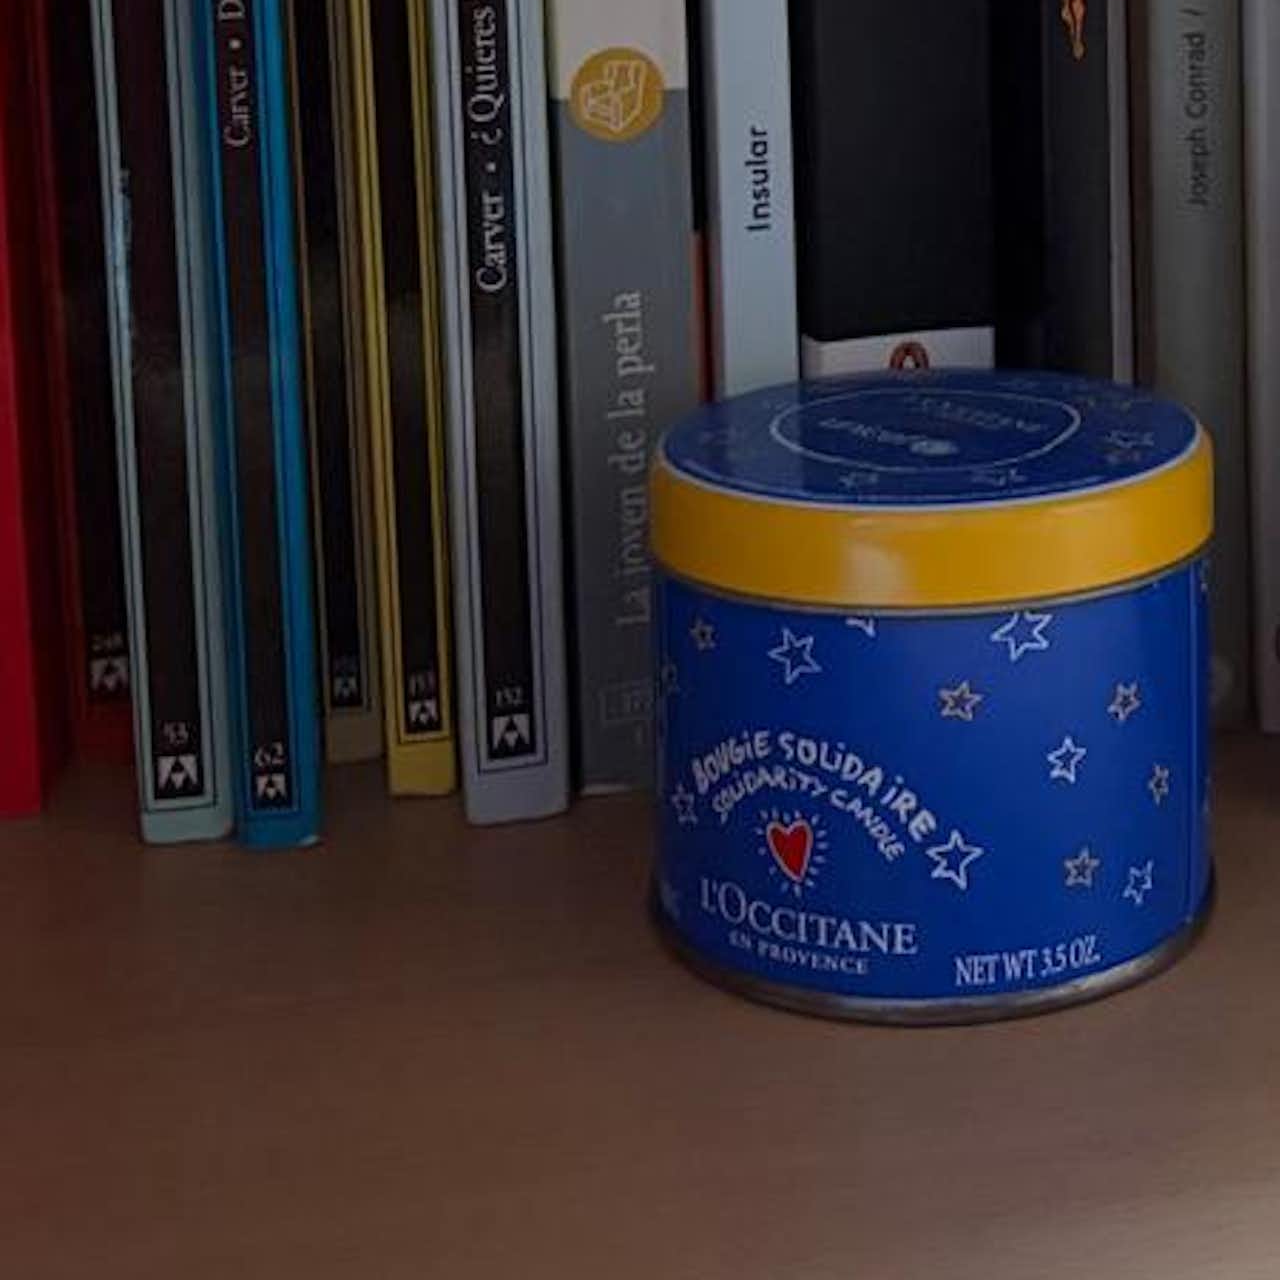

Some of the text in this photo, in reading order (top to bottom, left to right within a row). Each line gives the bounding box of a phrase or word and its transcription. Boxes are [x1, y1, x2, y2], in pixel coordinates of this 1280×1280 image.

[1183, 31, 1208, 117] Conrad
[744, 127, 770, 231] Insular
[1186, 130, 1212, 208] Joseph
[474, 190, 509, 292] Carver
[601, 289, 655, 377] perla
[601, 387, 646, 418] la
[607, 430, 647, 473] de
[611, 484, 650, 577] joven
[254, 739, 288, 767] 62
[830, 788, 907, 863] CANDLE
[758, 938, 869, 976] PROVENCE
[954, 954, 1000, 987] NET
[1001, 949, 1038, 981] WT
